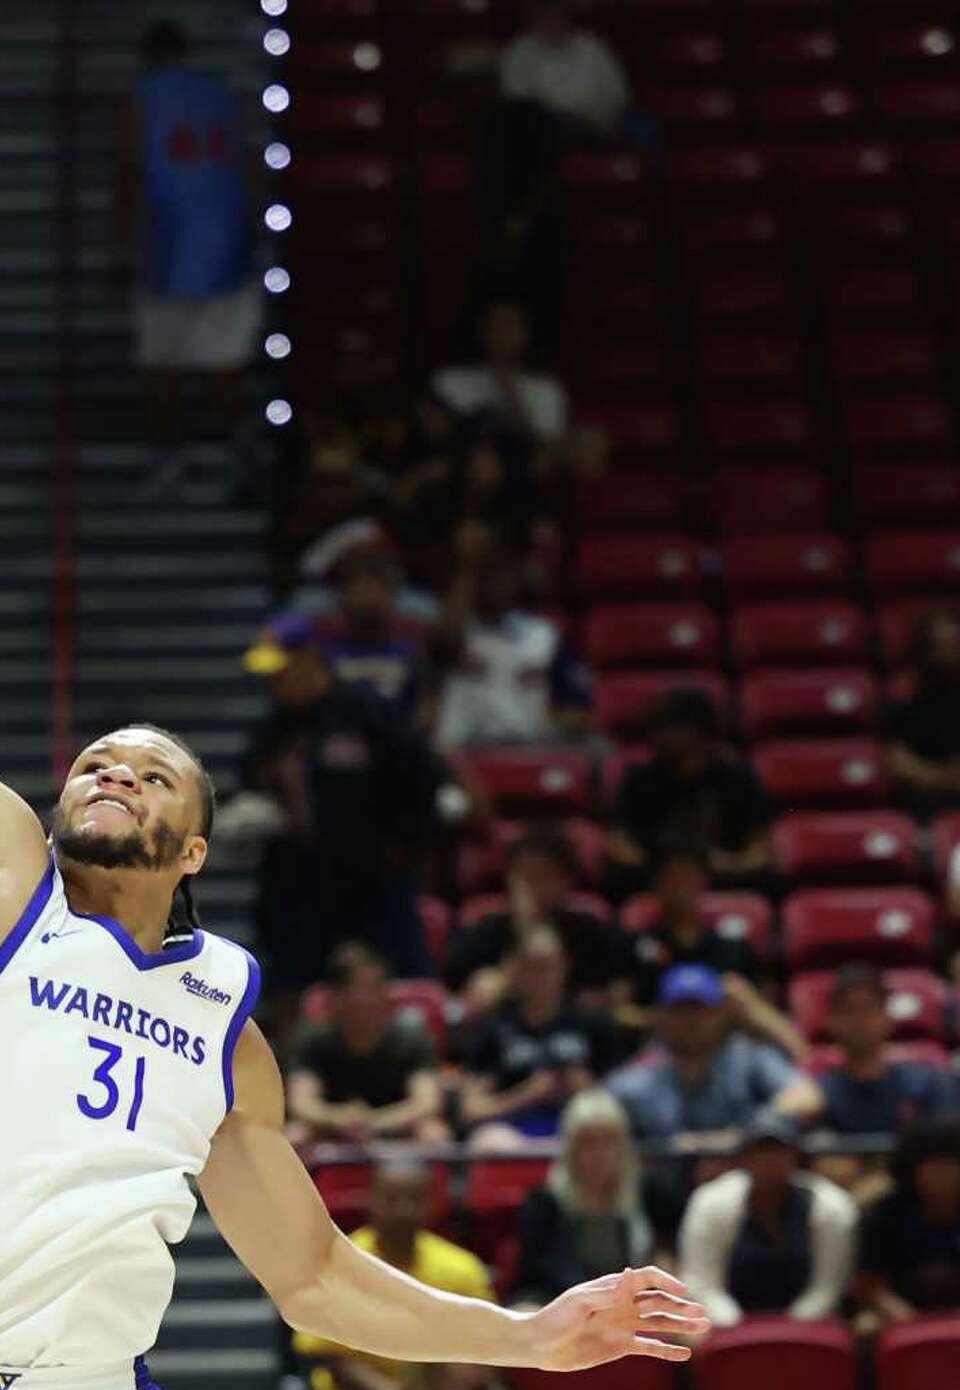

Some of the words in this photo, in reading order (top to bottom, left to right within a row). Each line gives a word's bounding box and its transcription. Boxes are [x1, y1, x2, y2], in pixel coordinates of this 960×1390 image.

[29, 976, 206, 1065] WARRIORS
[179, 971, 231, 1006] Rakuten
[76, 1036, 145, 1131] 31
